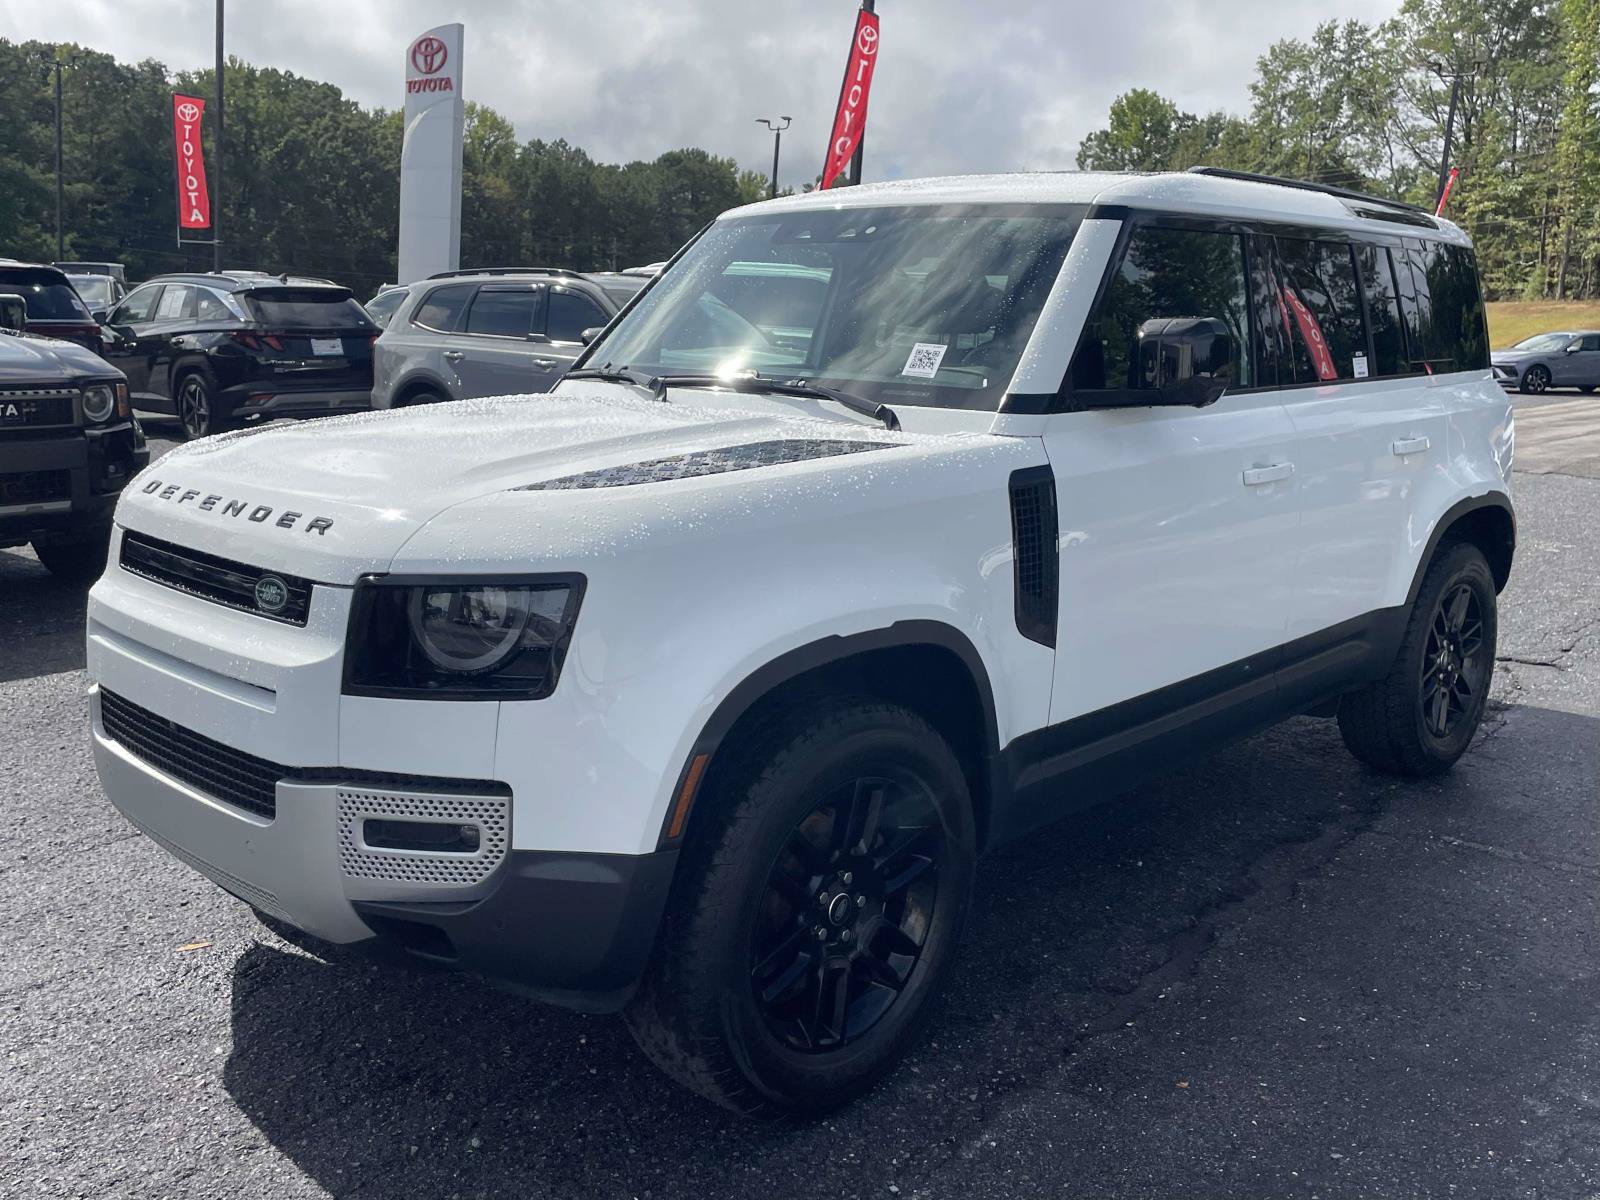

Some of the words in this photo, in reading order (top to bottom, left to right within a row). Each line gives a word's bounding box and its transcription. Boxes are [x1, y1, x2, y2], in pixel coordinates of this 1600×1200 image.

[406, 77, 453, 93] TOYOTA
[183, 124, 204, 222] TOYOTA
[142, 479, 334, 536] DEFENDER
